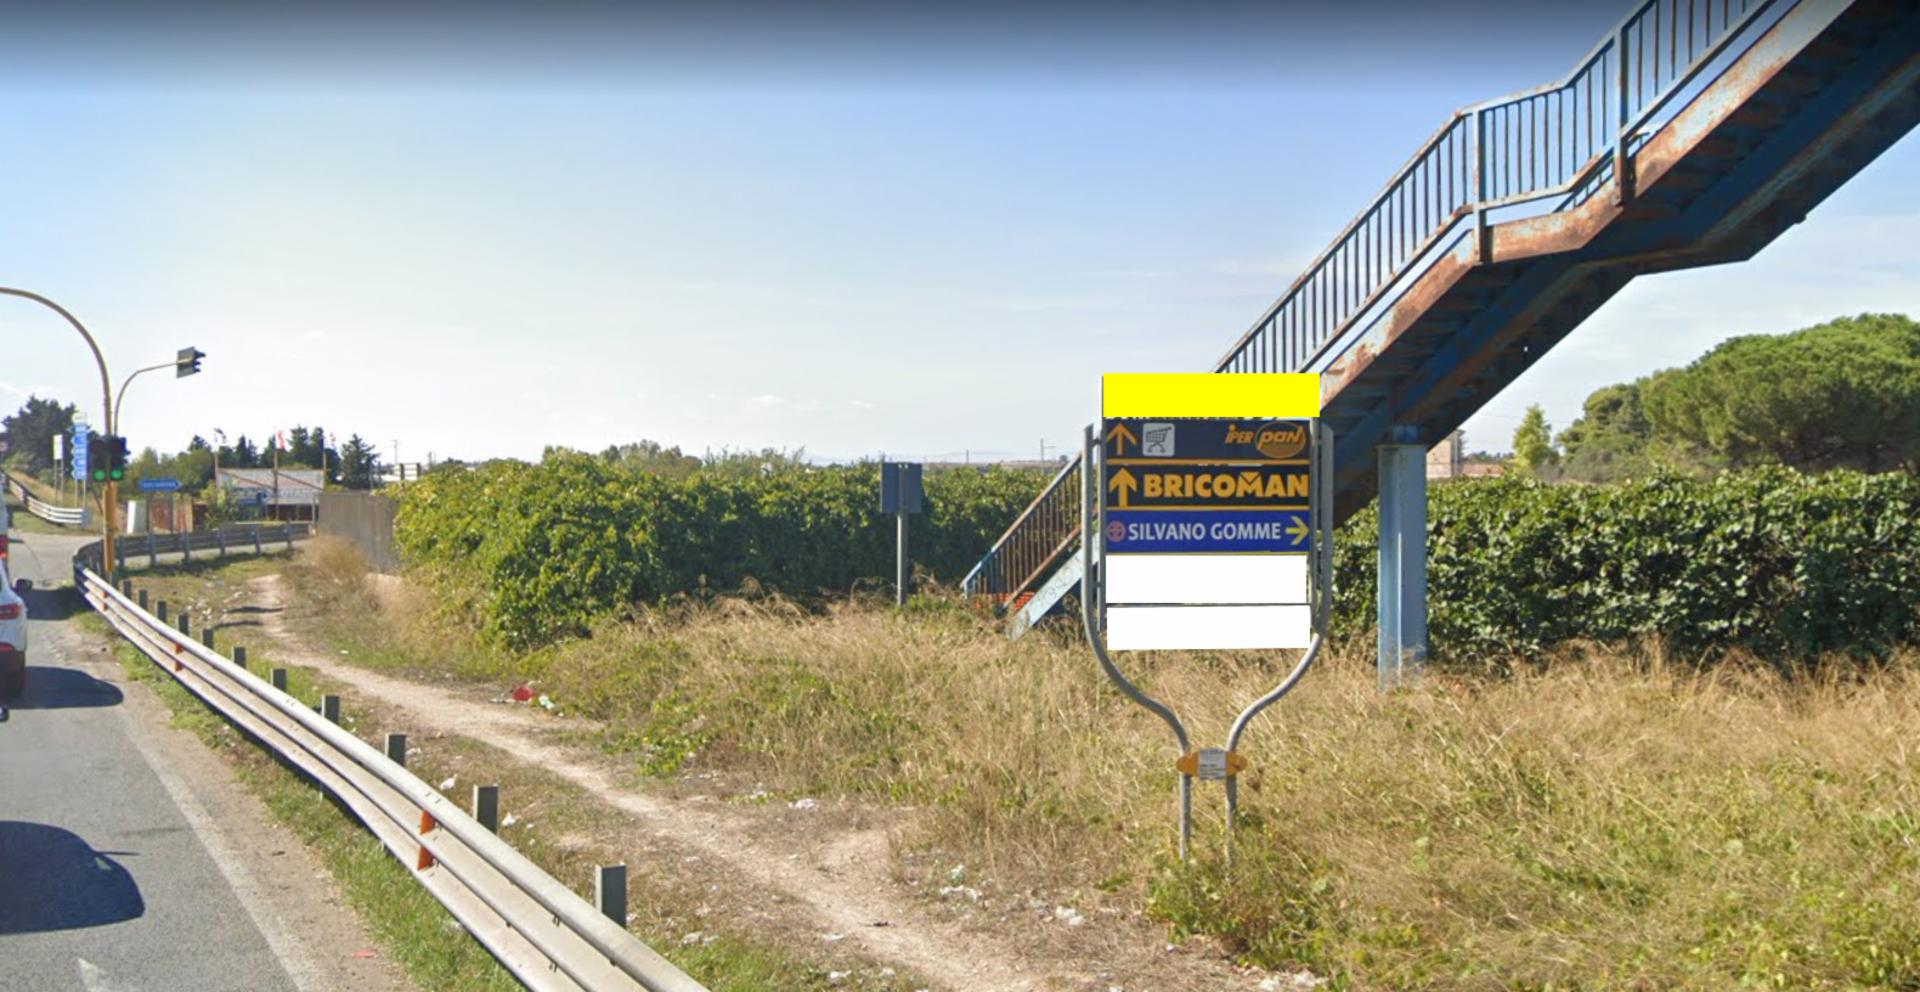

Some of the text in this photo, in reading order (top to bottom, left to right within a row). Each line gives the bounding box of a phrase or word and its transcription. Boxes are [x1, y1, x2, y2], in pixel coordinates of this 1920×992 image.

[1143, 472, 1309, 498] BRICOMAN
[1128, 522, 1281, 541] SILVANO GOMME
